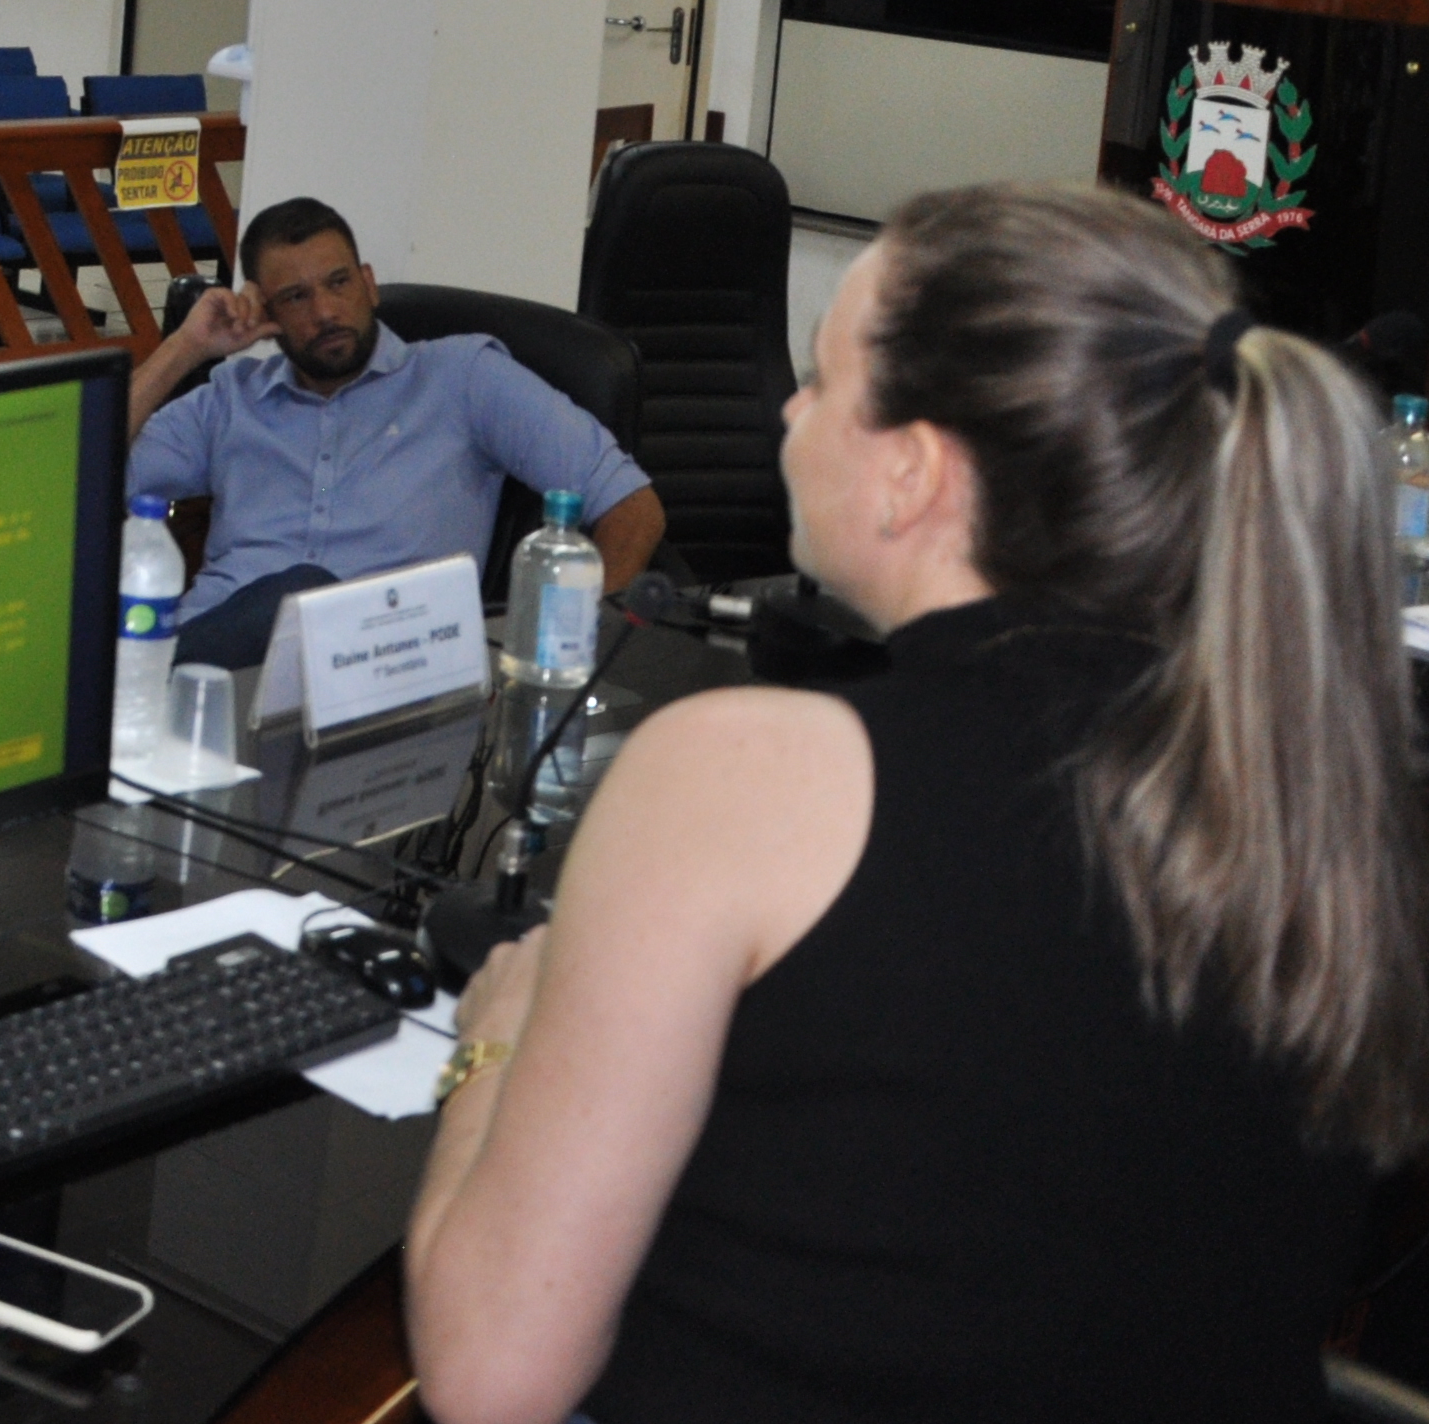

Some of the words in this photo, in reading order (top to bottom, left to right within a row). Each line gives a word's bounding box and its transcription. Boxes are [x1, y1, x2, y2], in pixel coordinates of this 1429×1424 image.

[123, 132, 196, 157] ATENÇÃO
[118, 164, 165, 182] PROIBIDO
[121, 185, 158, 201] SENTAR
[1176, 197, 1218, 240] TANGARÁ
[1219, 228, 1236, 240] DA
[1235, 211, 1272, 238] SERRA
[1276, 211, 1303, 224] 1976
